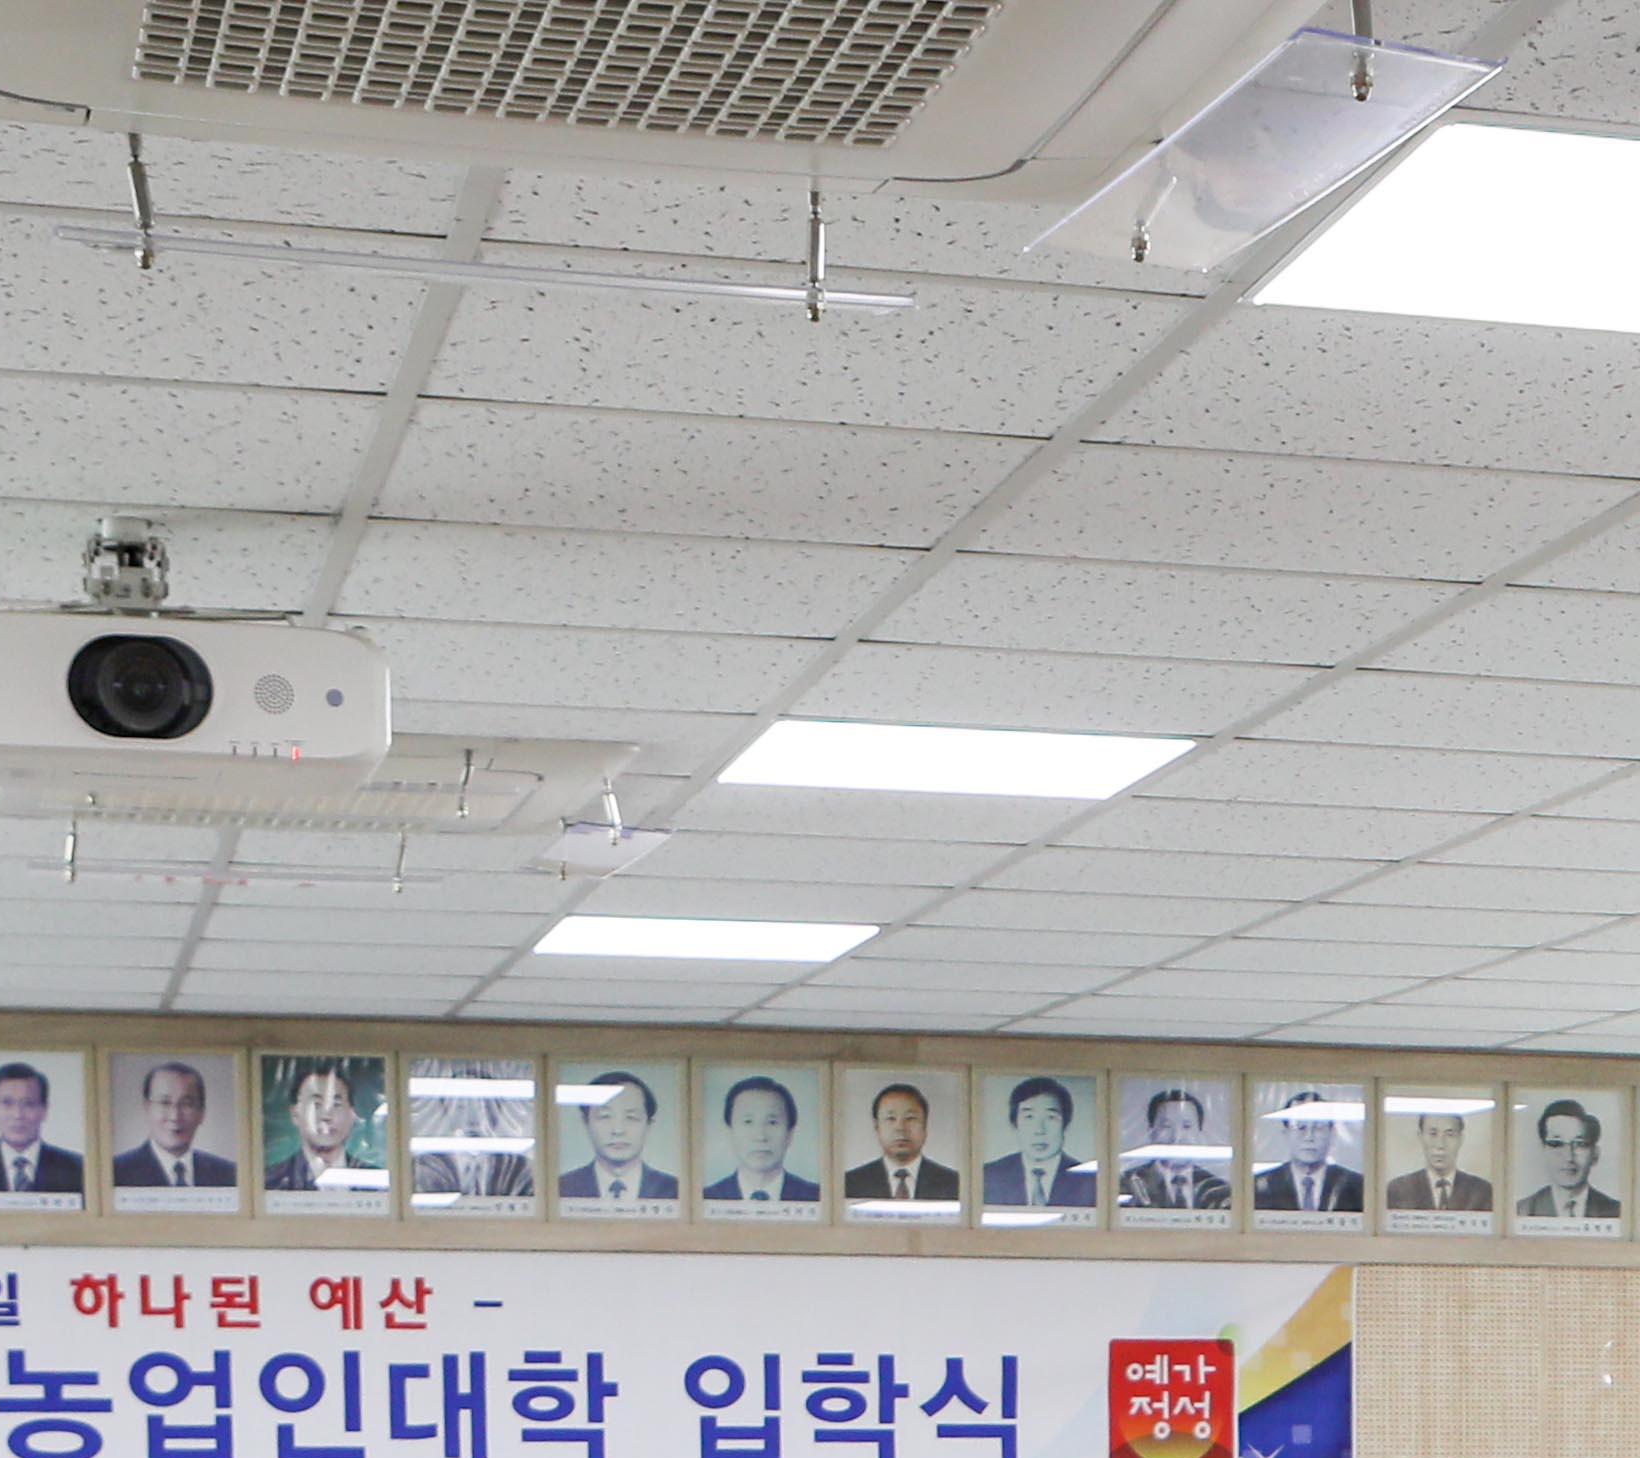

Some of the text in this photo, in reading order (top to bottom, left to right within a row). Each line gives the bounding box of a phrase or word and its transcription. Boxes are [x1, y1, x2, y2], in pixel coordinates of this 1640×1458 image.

[69, 1273, 261, 1329] 하나된
[308, 1276, 433, 1331] 예산
[1126, 1354, 1217, 1385] 예가
[1128, 1391, 1212, 1440] 정성
